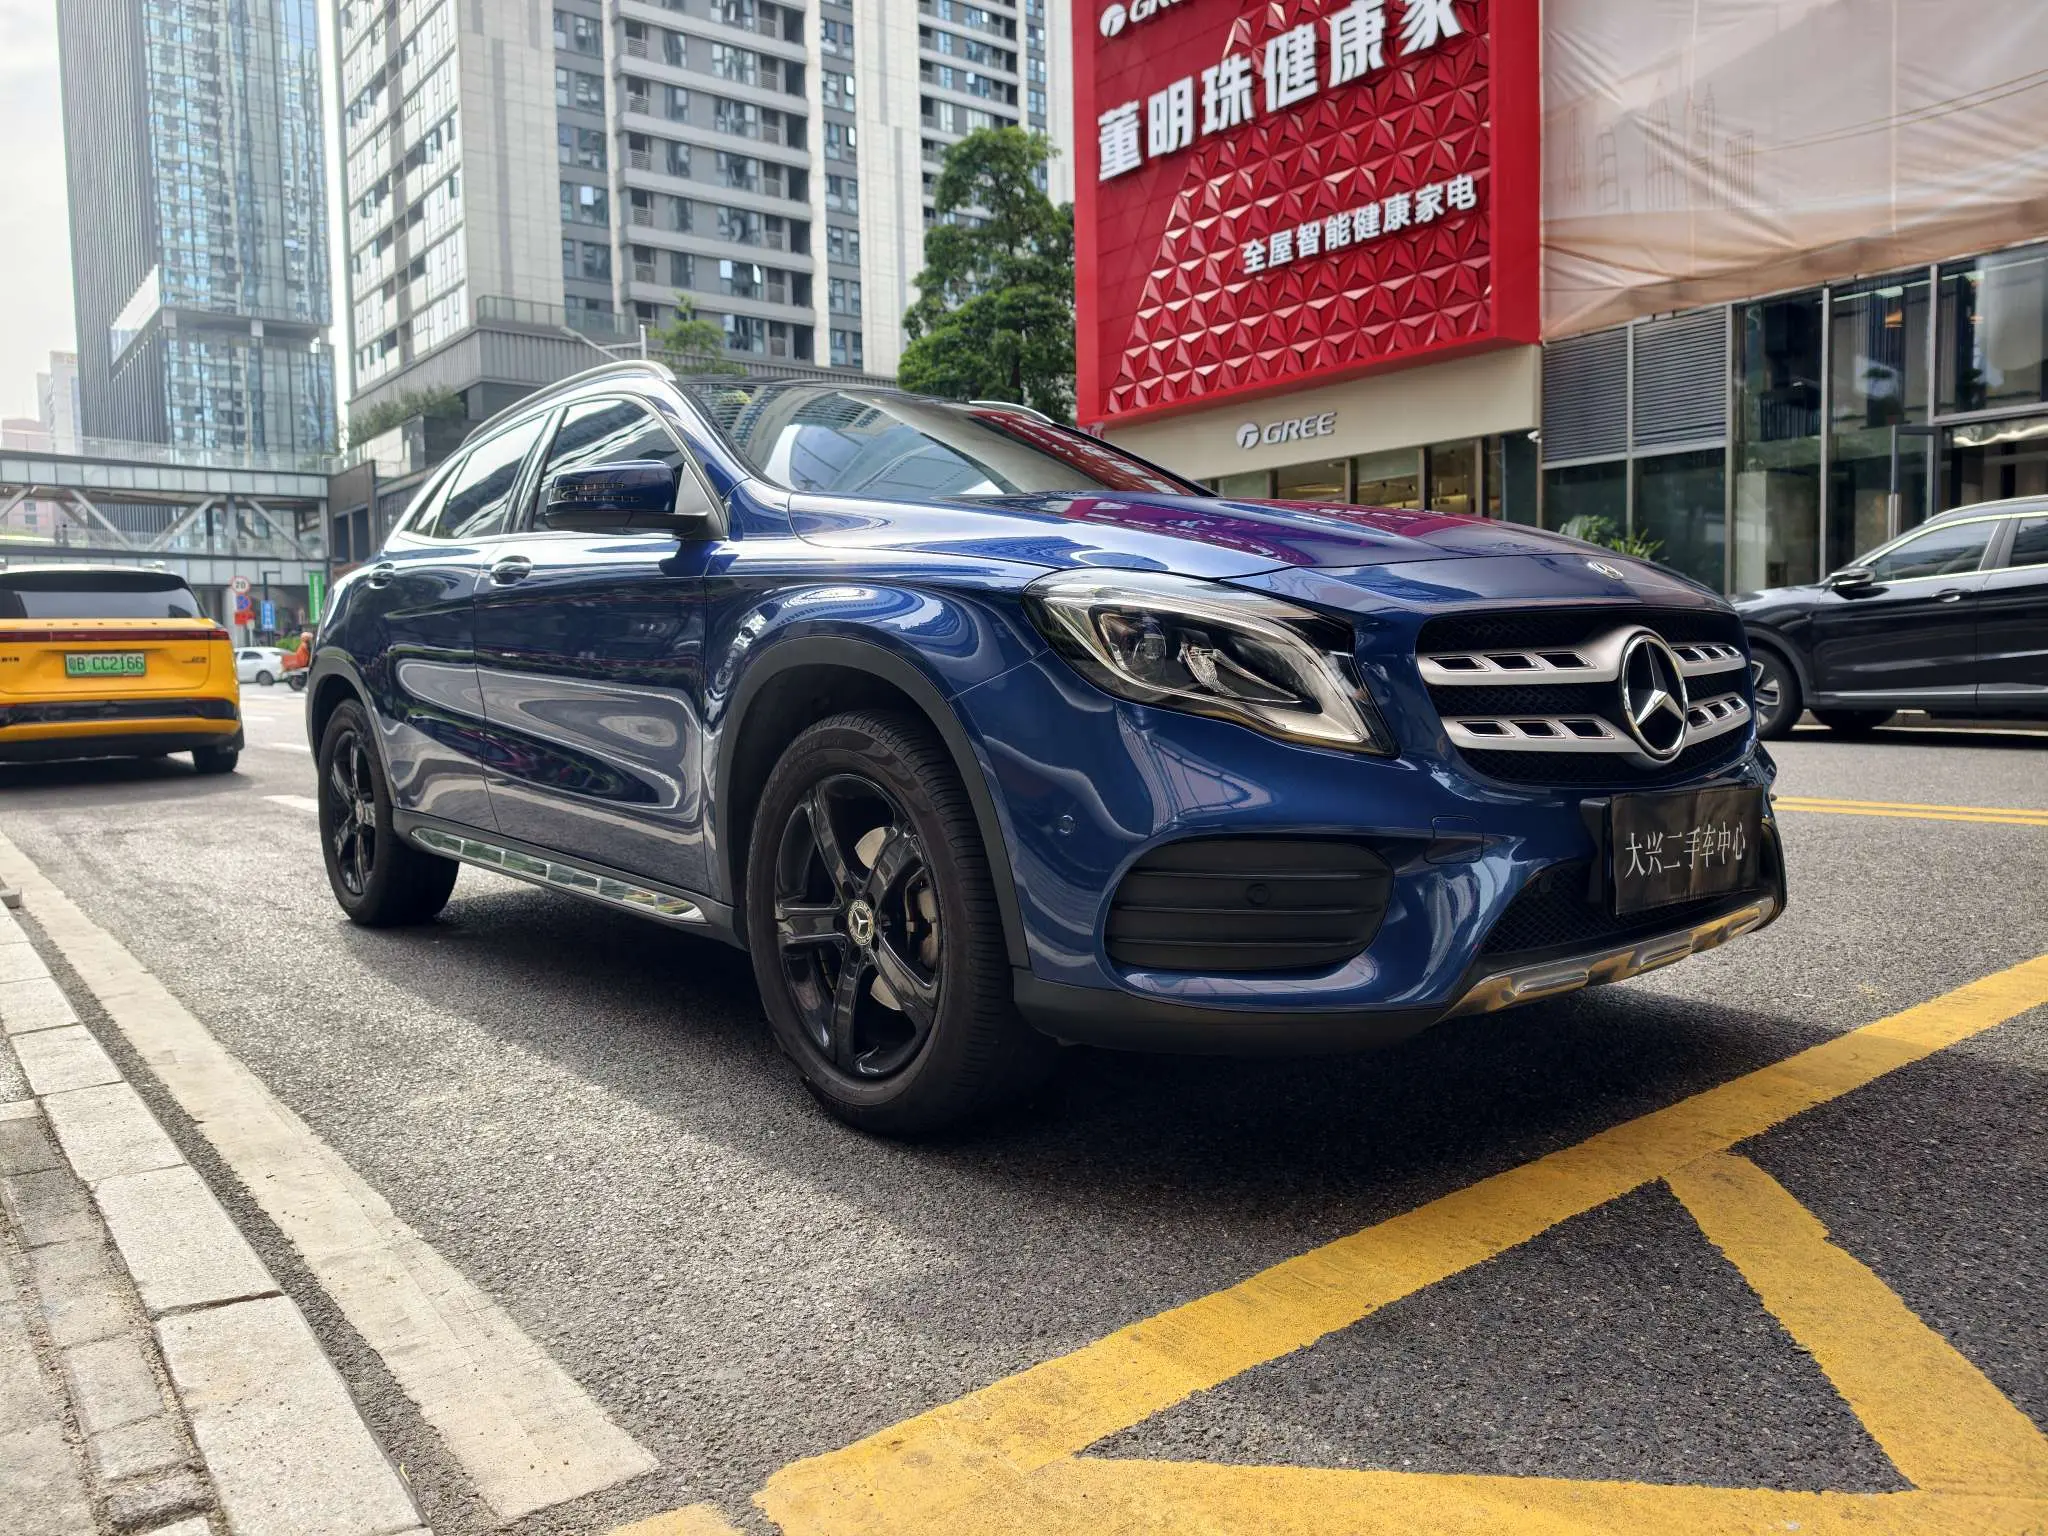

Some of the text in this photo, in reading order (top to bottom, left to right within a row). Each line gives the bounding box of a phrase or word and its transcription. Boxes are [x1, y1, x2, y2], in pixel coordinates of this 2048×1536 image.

[1242, 174, 1477, 275] 全屋智能健康家电
[1263, 411, 1338, 445] GREE
[1625, 820, 1746, 880] 大兴二手车中心
